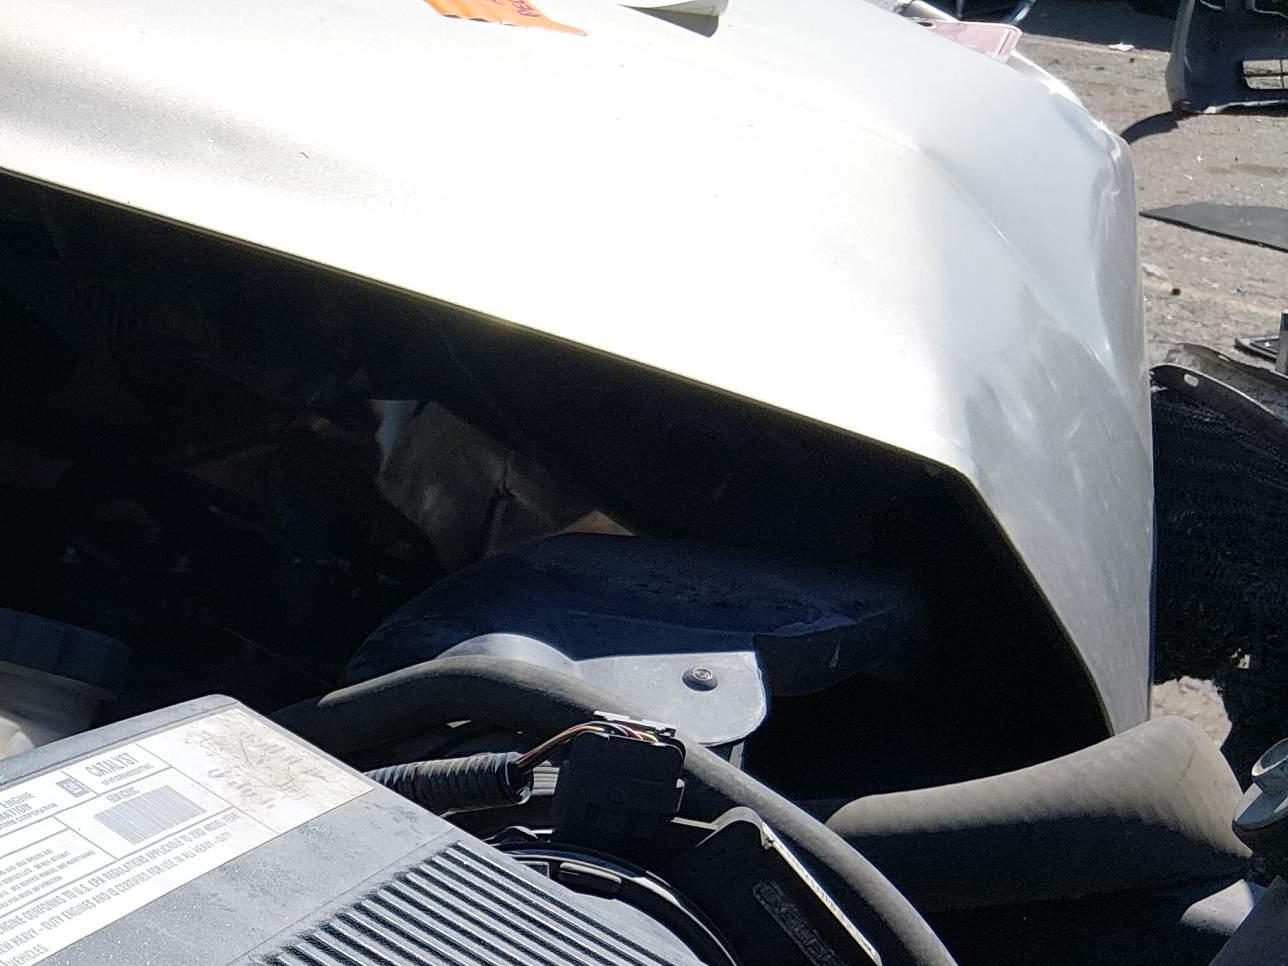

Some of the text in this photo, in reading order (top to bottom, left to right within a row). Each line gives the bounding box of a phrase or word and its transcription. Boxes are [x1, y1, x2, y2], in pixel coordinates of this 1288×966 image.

[84, 752, 139, 778] CATALYST
[0, 792, 36, 809] ENGINE
[9, 928, 40, 946] HEAVY
[60, 899, 97, 920] ENGINES
[91, 892, 112, 904] AND
[21, 895, 68, 920] CONFORMS
[61, 890, 78, 900] TO
